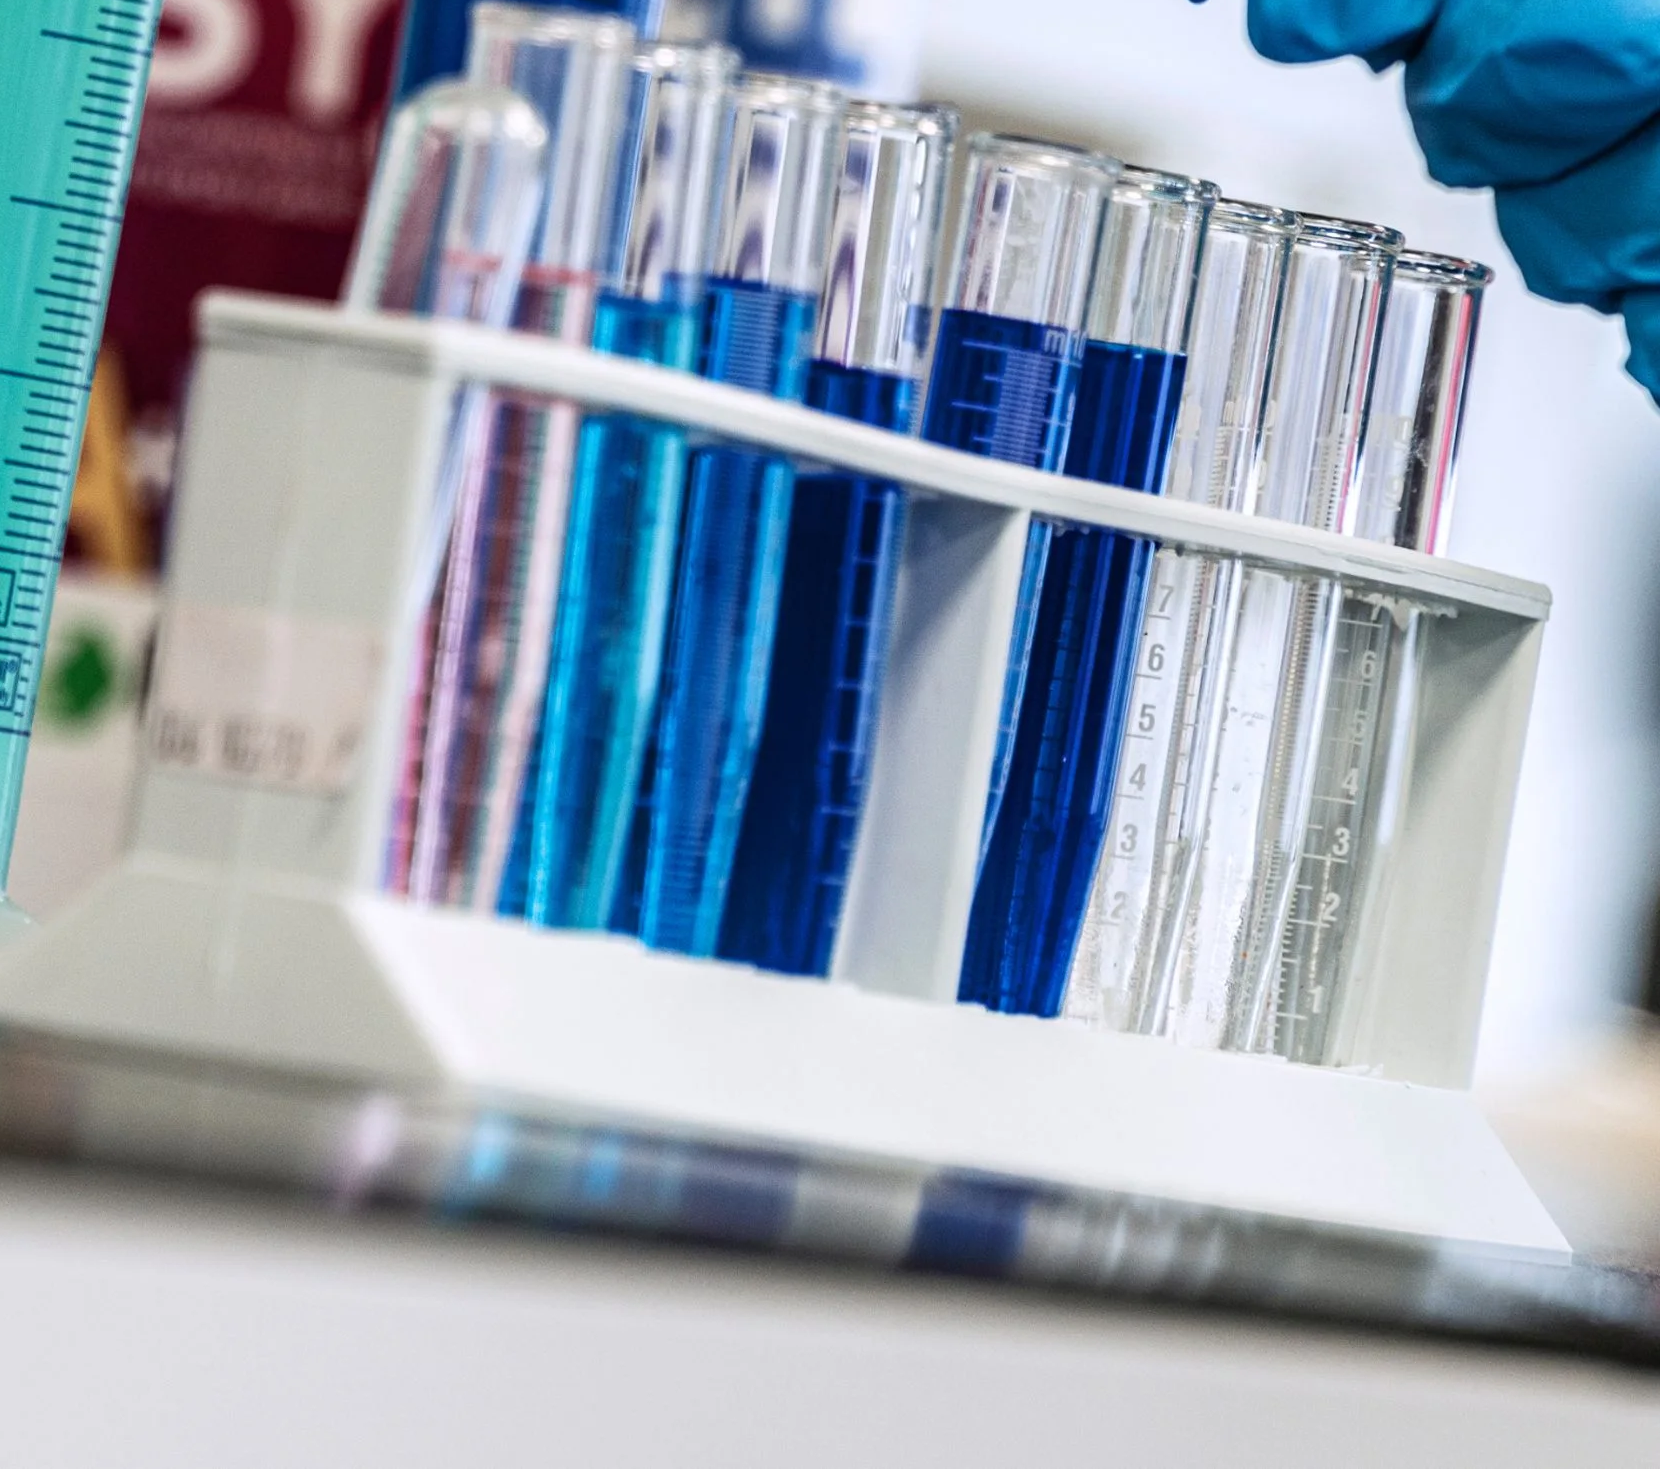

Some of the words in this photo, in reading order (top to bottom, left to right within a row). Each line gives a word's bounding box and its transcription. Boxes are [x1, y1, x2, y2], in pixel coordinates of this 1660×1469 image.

[1158, 584, 1174, 613] 7
[1148, 643, 1166, 672] 6
[1362, 650, 1377, 678] 6
[1139, 703, 1157, 732] 5
[1129, 763, 1147, 792] 4
[1342, 768, 1359, 796] 4
[1120, 824, 1138, 853] 3
[1332, 827, 1351, 856] 3
[1110, 891, 1129, 920] 2
[1321, 892, 1340, 921] 2
[1309, 985, 1324, 1014] 1
